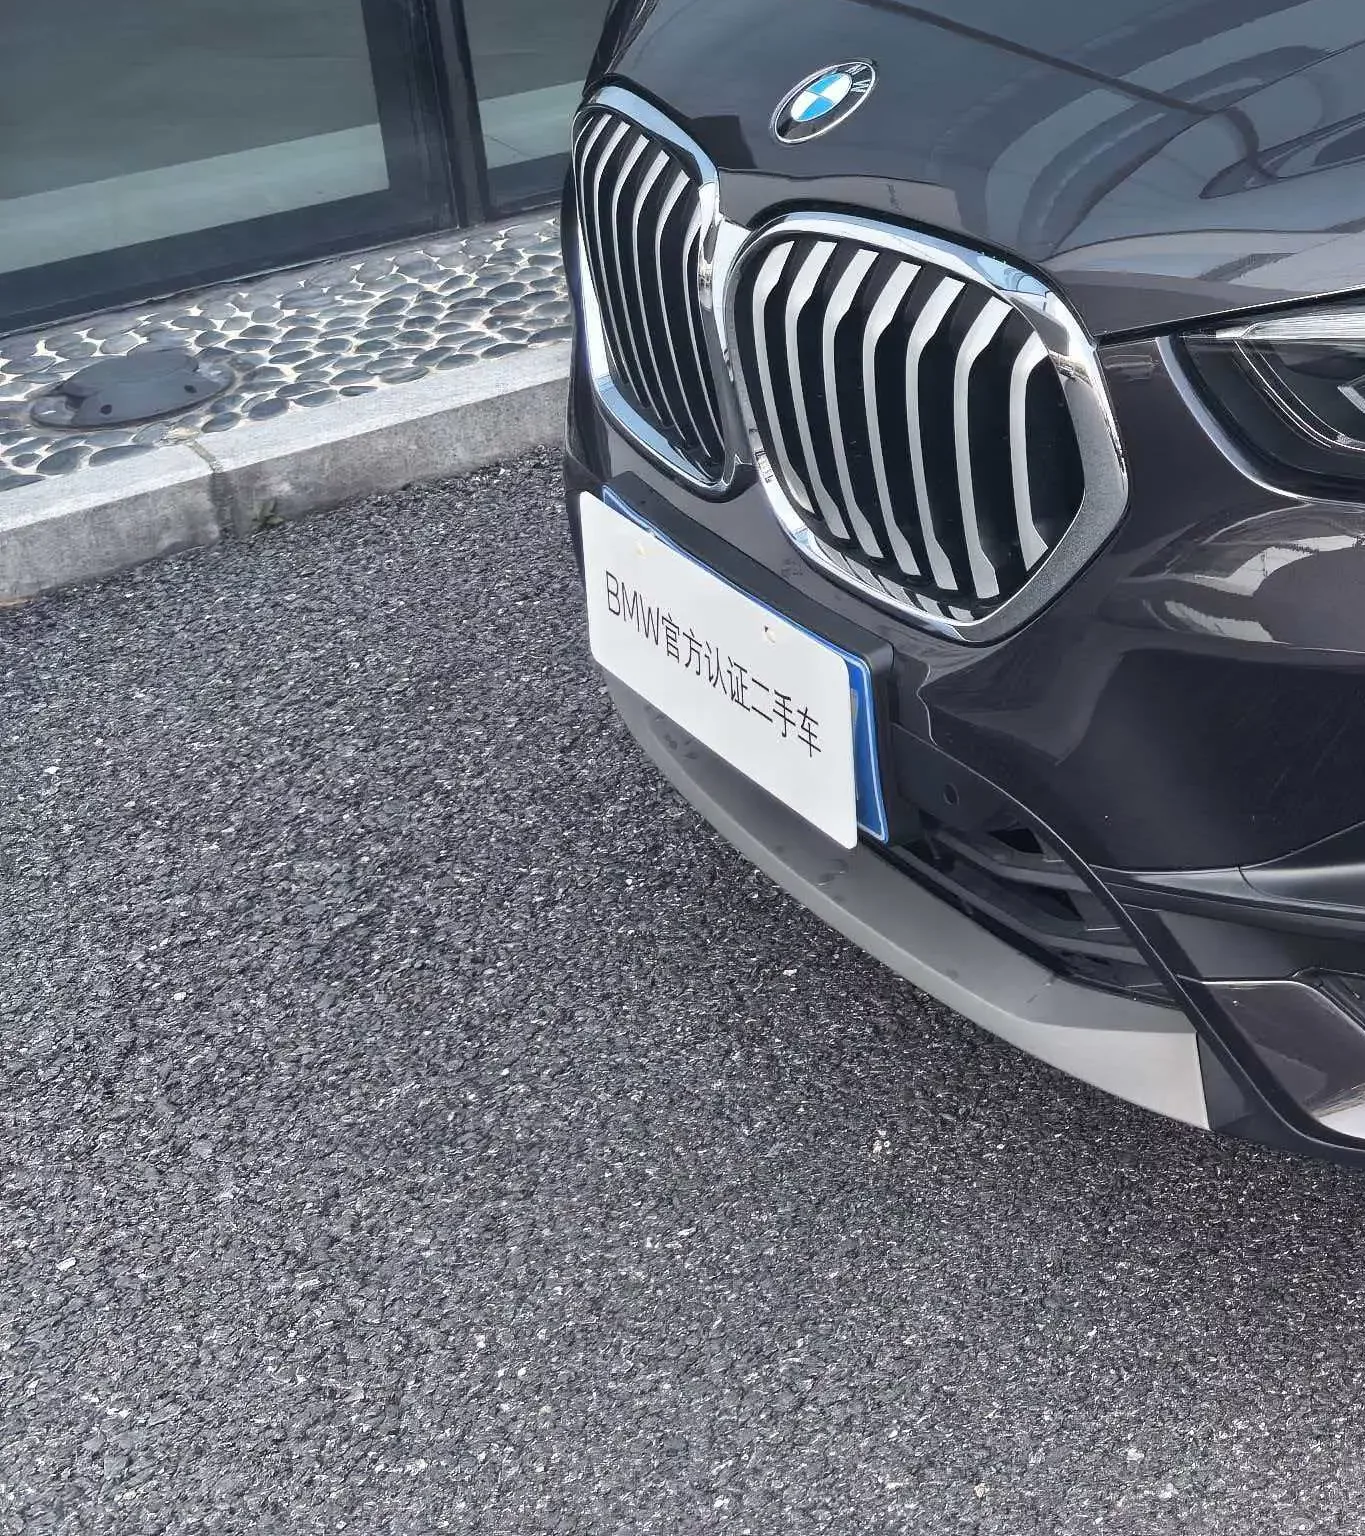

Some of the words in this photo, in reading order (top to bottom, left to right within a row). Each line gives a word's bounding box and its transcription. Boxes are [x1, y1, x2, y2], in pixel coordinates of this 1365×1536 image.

[606, 570, 822, 758] BMW官方认证二手车
